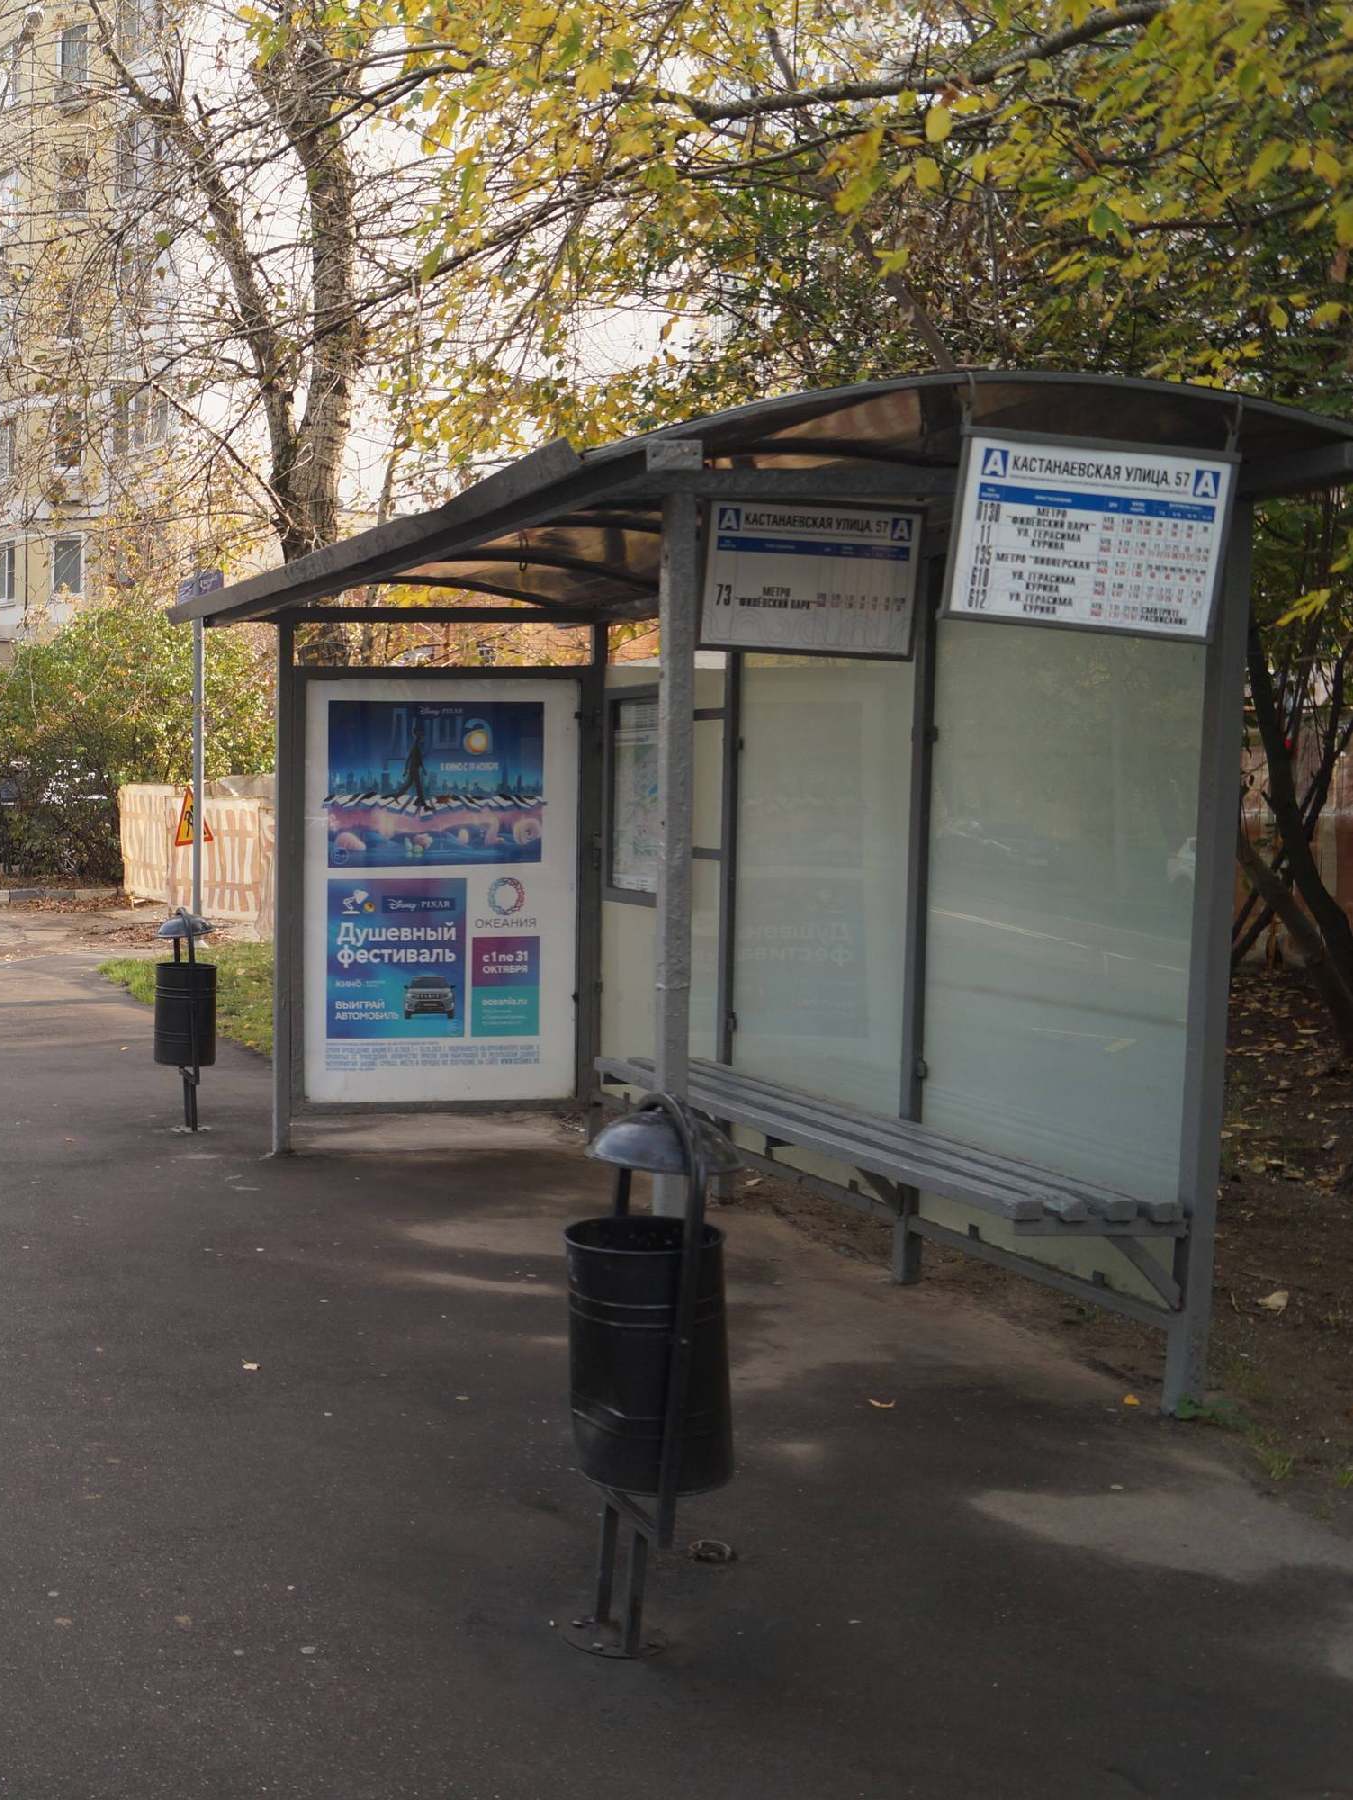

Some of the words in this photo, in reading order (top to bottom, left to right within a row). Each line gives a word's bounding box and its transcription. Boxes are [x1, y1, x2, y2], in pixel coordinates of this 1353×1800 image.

[1011, 455, 1122, 480] КАСТАНАЕВСКАЯ
[1175, 471, 1191, 487] 57
[1036, 507, 1067, 519] МЕТРО
[744, 511, 833, 530] КАСТАНАЕВСКАЯ
[875, 520, 889, 534] 57
[975, 544, 993, 566] 135
[996, 551, 1027, 564] МЕТРО
[970, 565, 990, 588] 610
[715, 583, 732, 606] 73
[763, 586, 791, 598] МЕТРО
[968, 588, 987, 609] 612
[388, 898, 416, 912] Disney
[421, 900, 451, 909] PIXAR
[474, 917, 537, 929] ОКЕАНИЯ
[336, 921, 456, 947] Душевный
[336, 943, 456, 968] фестиваль
[491, 950, 497, 962] 1
[498, 953, 514, 962] по
[515, 950, 529, 962] 31
[482, 965, 528, 975] ОКТЯБРЯ
[335, 998, 385, 1010] ВЫИГРАЙ
[335, 1010, 399, 1021] АВТОМОБИЛЬ
